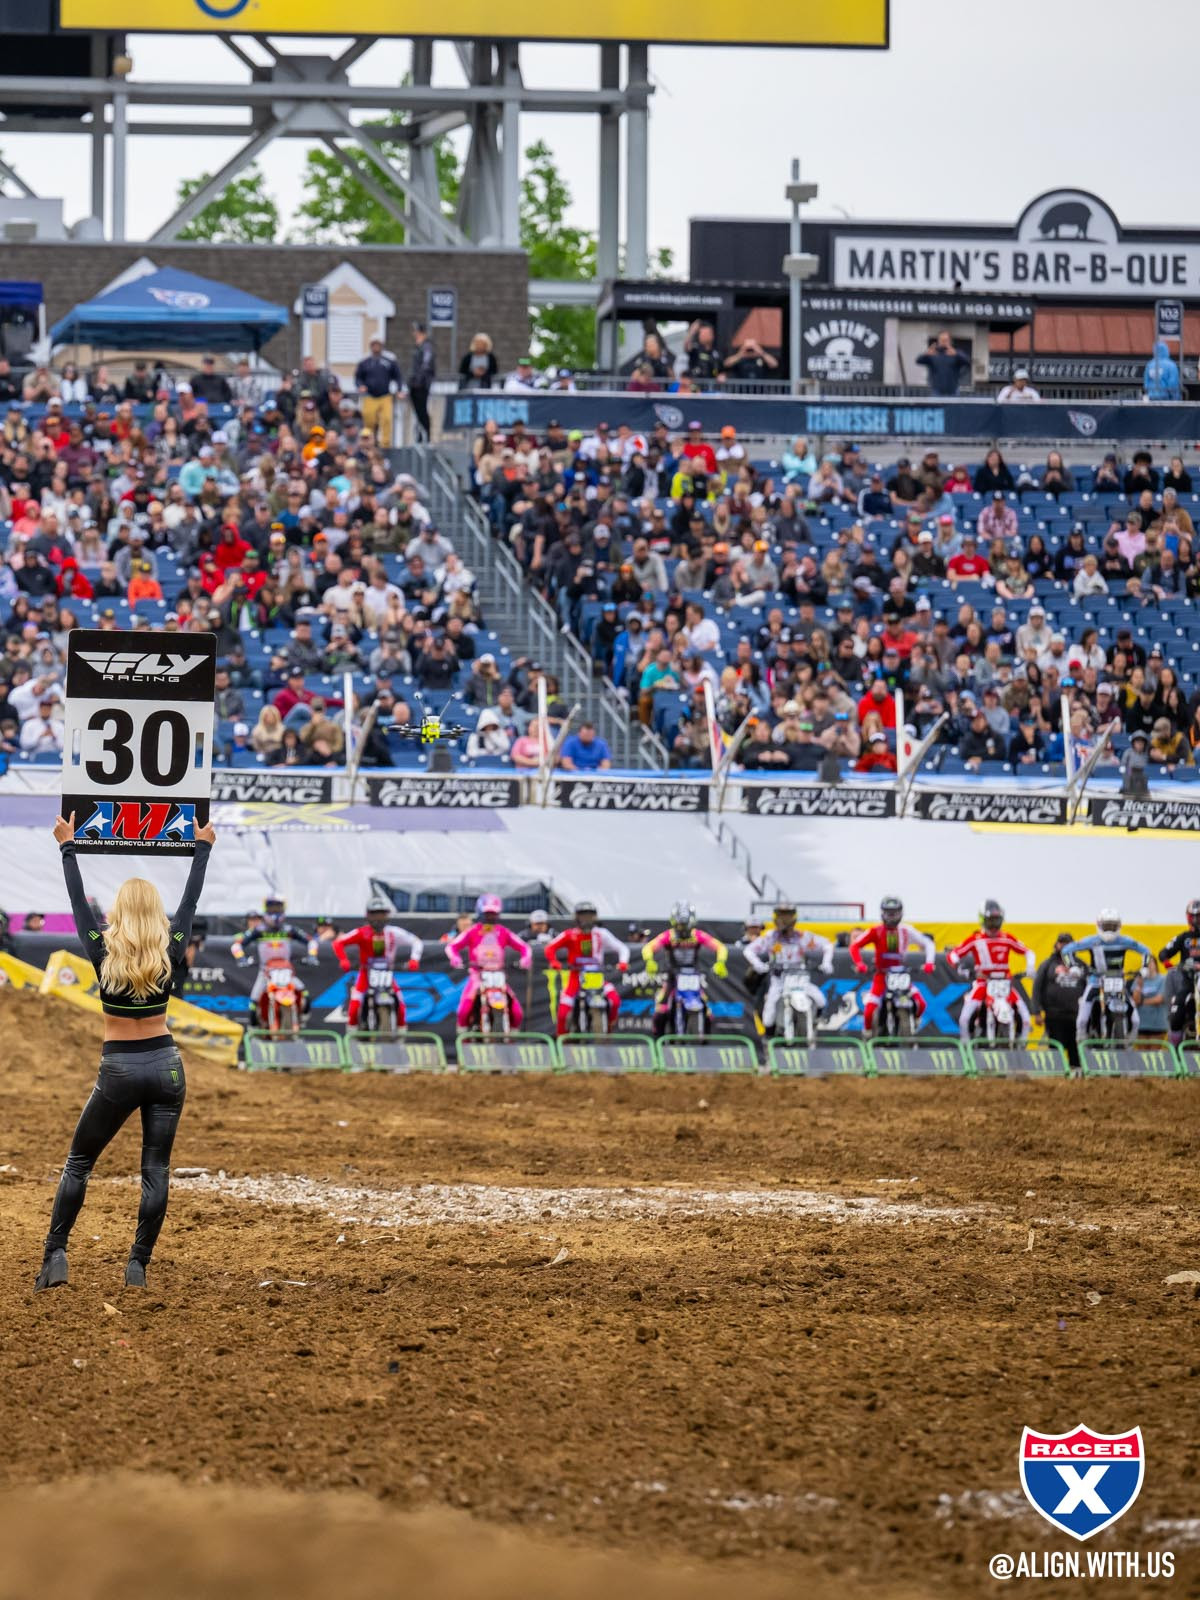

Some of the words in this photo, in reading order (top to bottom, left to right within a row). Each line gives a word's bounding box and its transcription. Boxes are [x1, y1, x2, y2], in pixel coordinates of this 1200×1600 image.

[849, 248, 1000, 282] MARTIN'S
[1012, 252, 1188, 286] BAR-B-QUE
[809, 297, 843, 312] WEST
[847, 298, 914, 313] TENNESSEE
[917, 301, 962, 315] WHOLE
[965, 303, 994, 316] HOG
[805, 406, 889, 433] TENNESSEE
[74, 651, 211, 676] FLY
[102, 673, 180, 683] RACING
[85, 707, 191, 787] 30
[213, 773, 255, 787] ROCKY
[400, 779, 442, 792] ROCKY
[590, 781, 632, 794] ROCKY
[778, 787, 819, 800] ROCKY
[949, 793, 991, 806] ROCKY
[1123, 799, 1163, 814] ROCKY
[73, 801, 196, 841] AMA
[73, 839, 104, 847] MERICAN
[104, 839, 156, 848] MOTORCYCLIST
[156, 841, 196, 849] ASSOCIATIO
